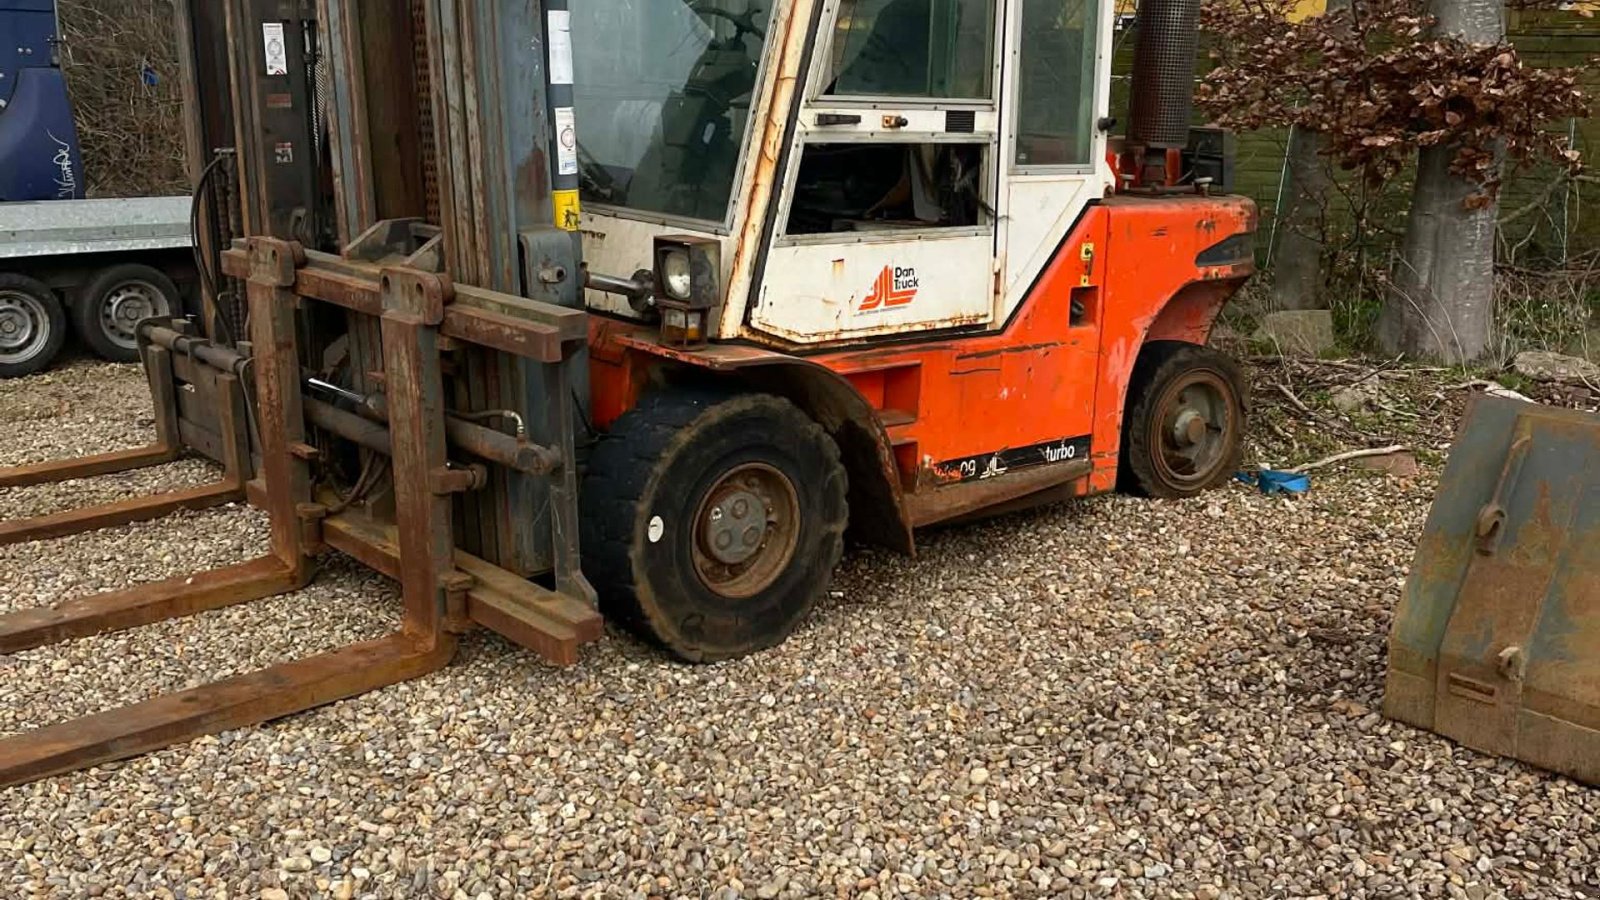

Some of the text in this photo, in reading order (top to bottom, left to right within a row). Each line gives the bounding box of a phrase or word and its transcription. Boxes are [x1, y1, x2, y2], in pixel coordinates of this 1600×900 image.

[894, 267, 915, 278] Dan
[894, 277, 919, 290] Truck
[1045, 443, 1075, 462] turbo
